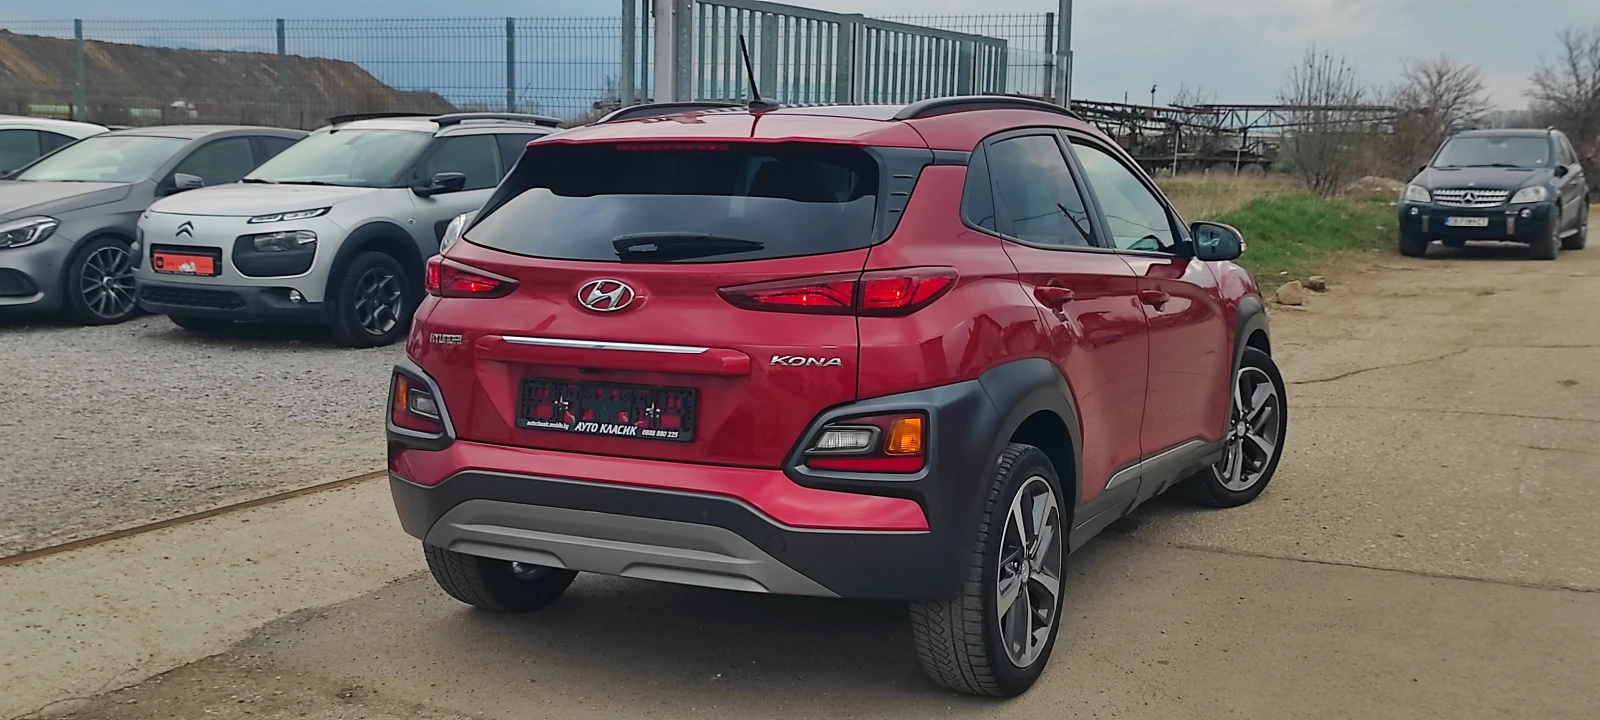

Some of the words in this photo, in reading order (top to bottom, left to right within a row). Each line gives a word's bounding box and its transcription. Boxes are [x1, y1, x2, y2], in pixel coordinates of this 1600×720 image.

[430, 333, 462, 344] HYUNDAI
[770, 355, 842, 367] KONA
[574, 421, 599, 433] АУТО
[599, 423, 638, 436] КЛАСИК
[641, 429, 656, 437] 0888
